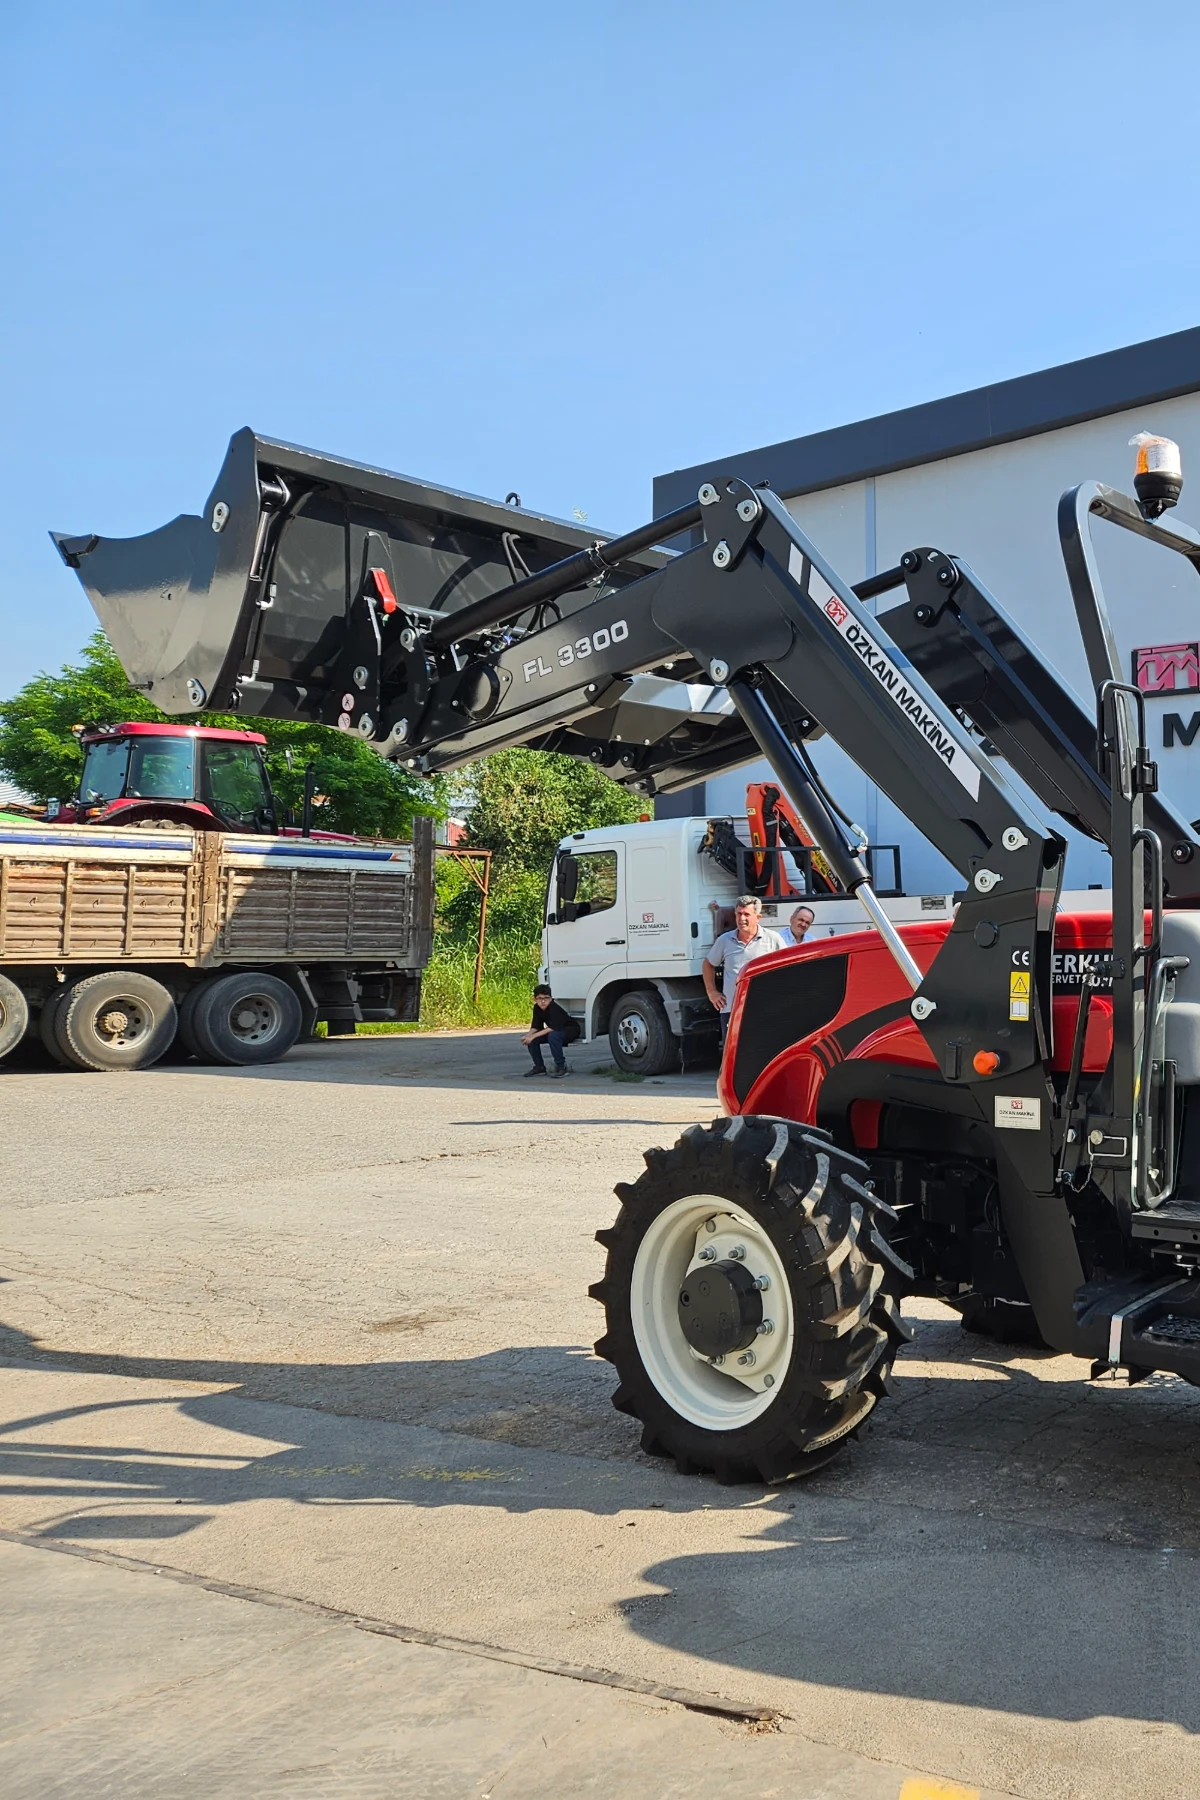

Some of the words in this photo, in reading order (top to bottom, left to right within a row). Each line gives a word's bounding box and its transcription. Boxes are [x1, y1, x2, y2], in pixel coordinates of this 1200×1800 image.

[522, 656, 553, 683] FL
[557, 619, 629, 667] 3300
[845, 624, 899, 691] ÖZKAN
[895, 686, 956, 765] MAKİNA
[1011, 950, 1030, 966] CE
